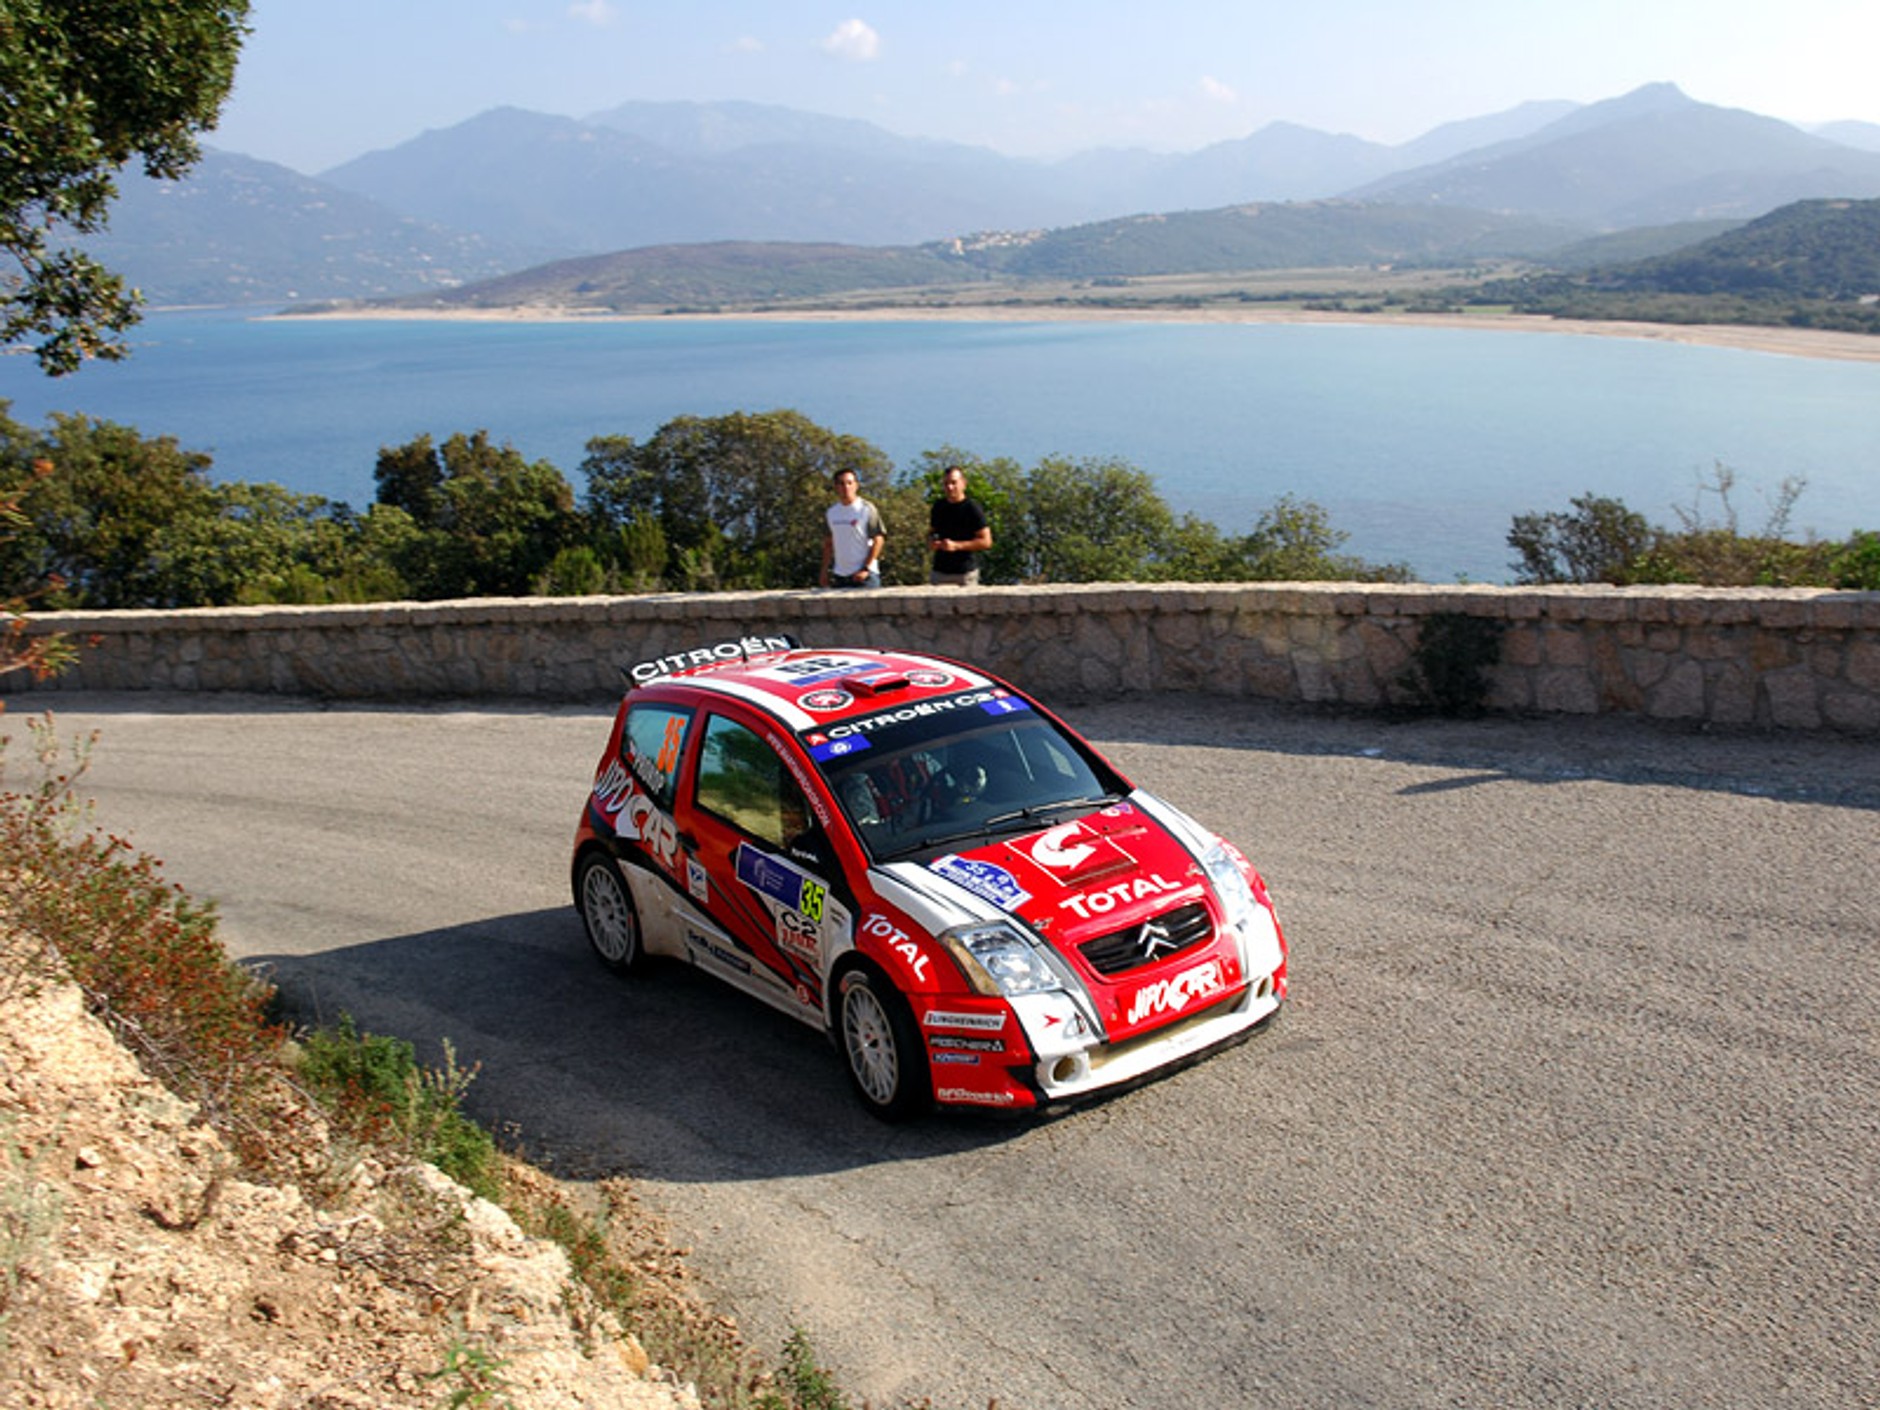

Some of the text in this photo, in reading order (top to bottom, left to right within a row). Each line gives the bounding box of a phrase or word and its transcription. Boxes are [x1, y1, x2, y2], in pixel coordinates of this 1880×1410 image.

[631, 636, 790, 681] CITROËN
[829, 699, 955, 738] CITROËN
[801, 879, 826, 922] 35
[1059, 873, 1183, 919] TOTAL
[781, 911, 817, 935] C2
[862, 912, 930, 984] TOTAL
